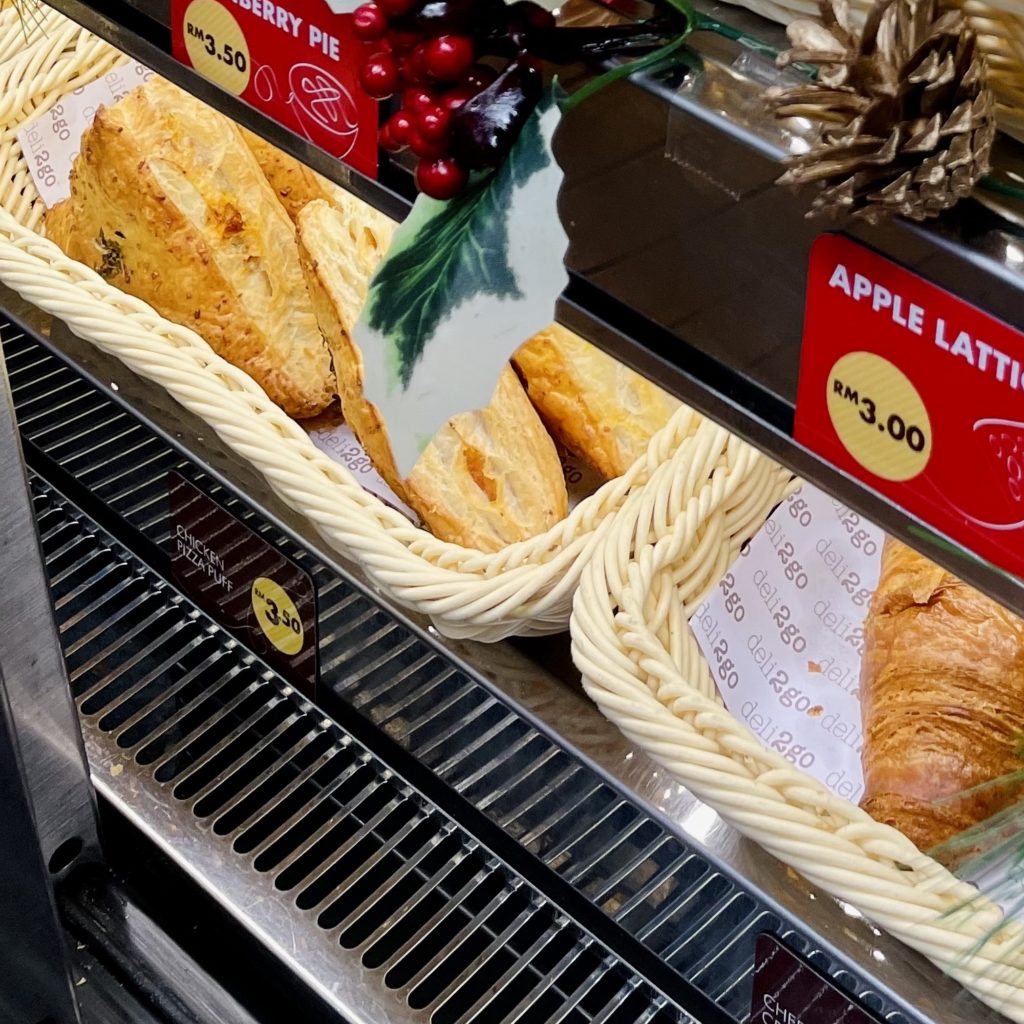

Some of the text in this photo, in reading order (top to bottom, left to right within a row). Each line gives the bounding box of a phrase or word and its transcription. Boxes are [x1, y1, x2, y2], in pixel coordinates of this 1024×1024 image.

[187, 22, 247, 73] RM3.50
[309, 24, 340, 61] PIE
[829, 264, 925, 336] APPLE
[833, 379, 925, 452] RM3.00
[176, 524, 225, 571] CHICKEN
[177, 539, 233, 592] PIZZA PUFF
[753, 569, 807, 653] deli2go
[747, 634, 811, 712] deli2go
